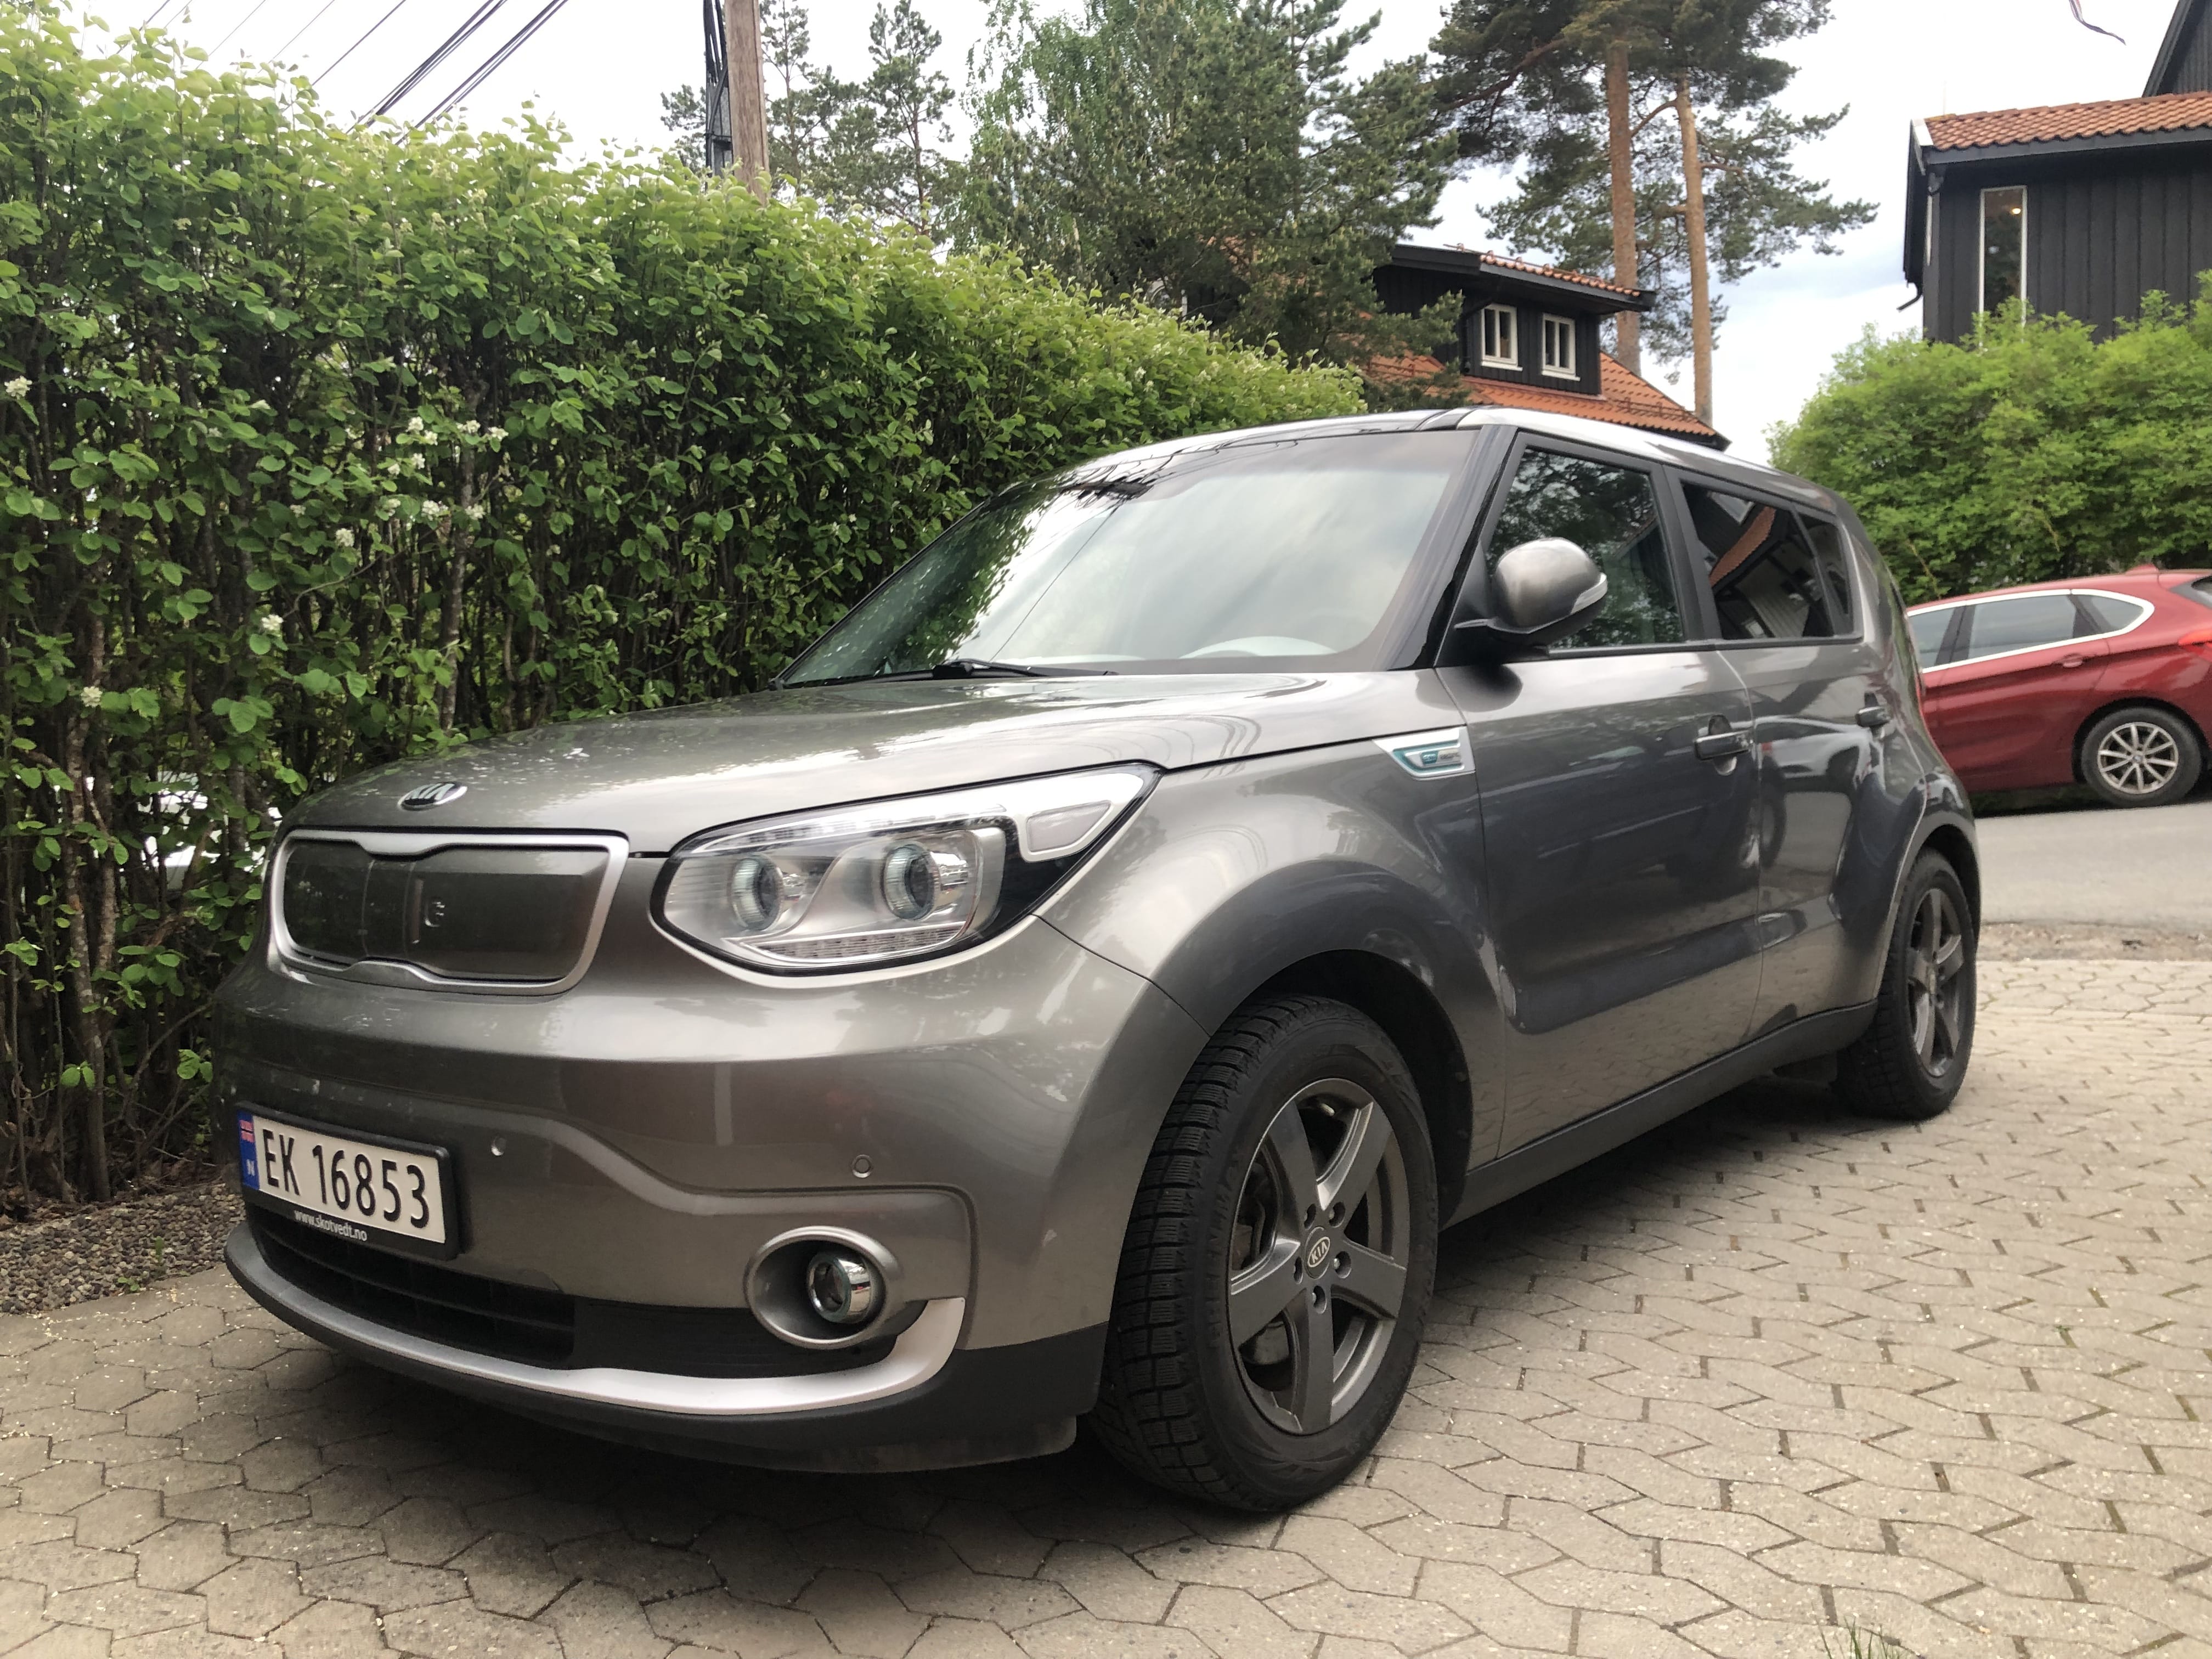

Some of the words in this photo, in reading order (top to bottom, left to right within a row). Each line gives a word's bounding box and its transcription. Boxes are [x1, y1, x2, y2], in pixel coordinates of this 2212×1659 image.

[262, 1128, 301, 1196] EK
[312, 1144, 430, 1229] 16853
[294, 1210, 368, 1242] www.skotvedt.no
[1310, 1240, 1328, 1263] KIA
